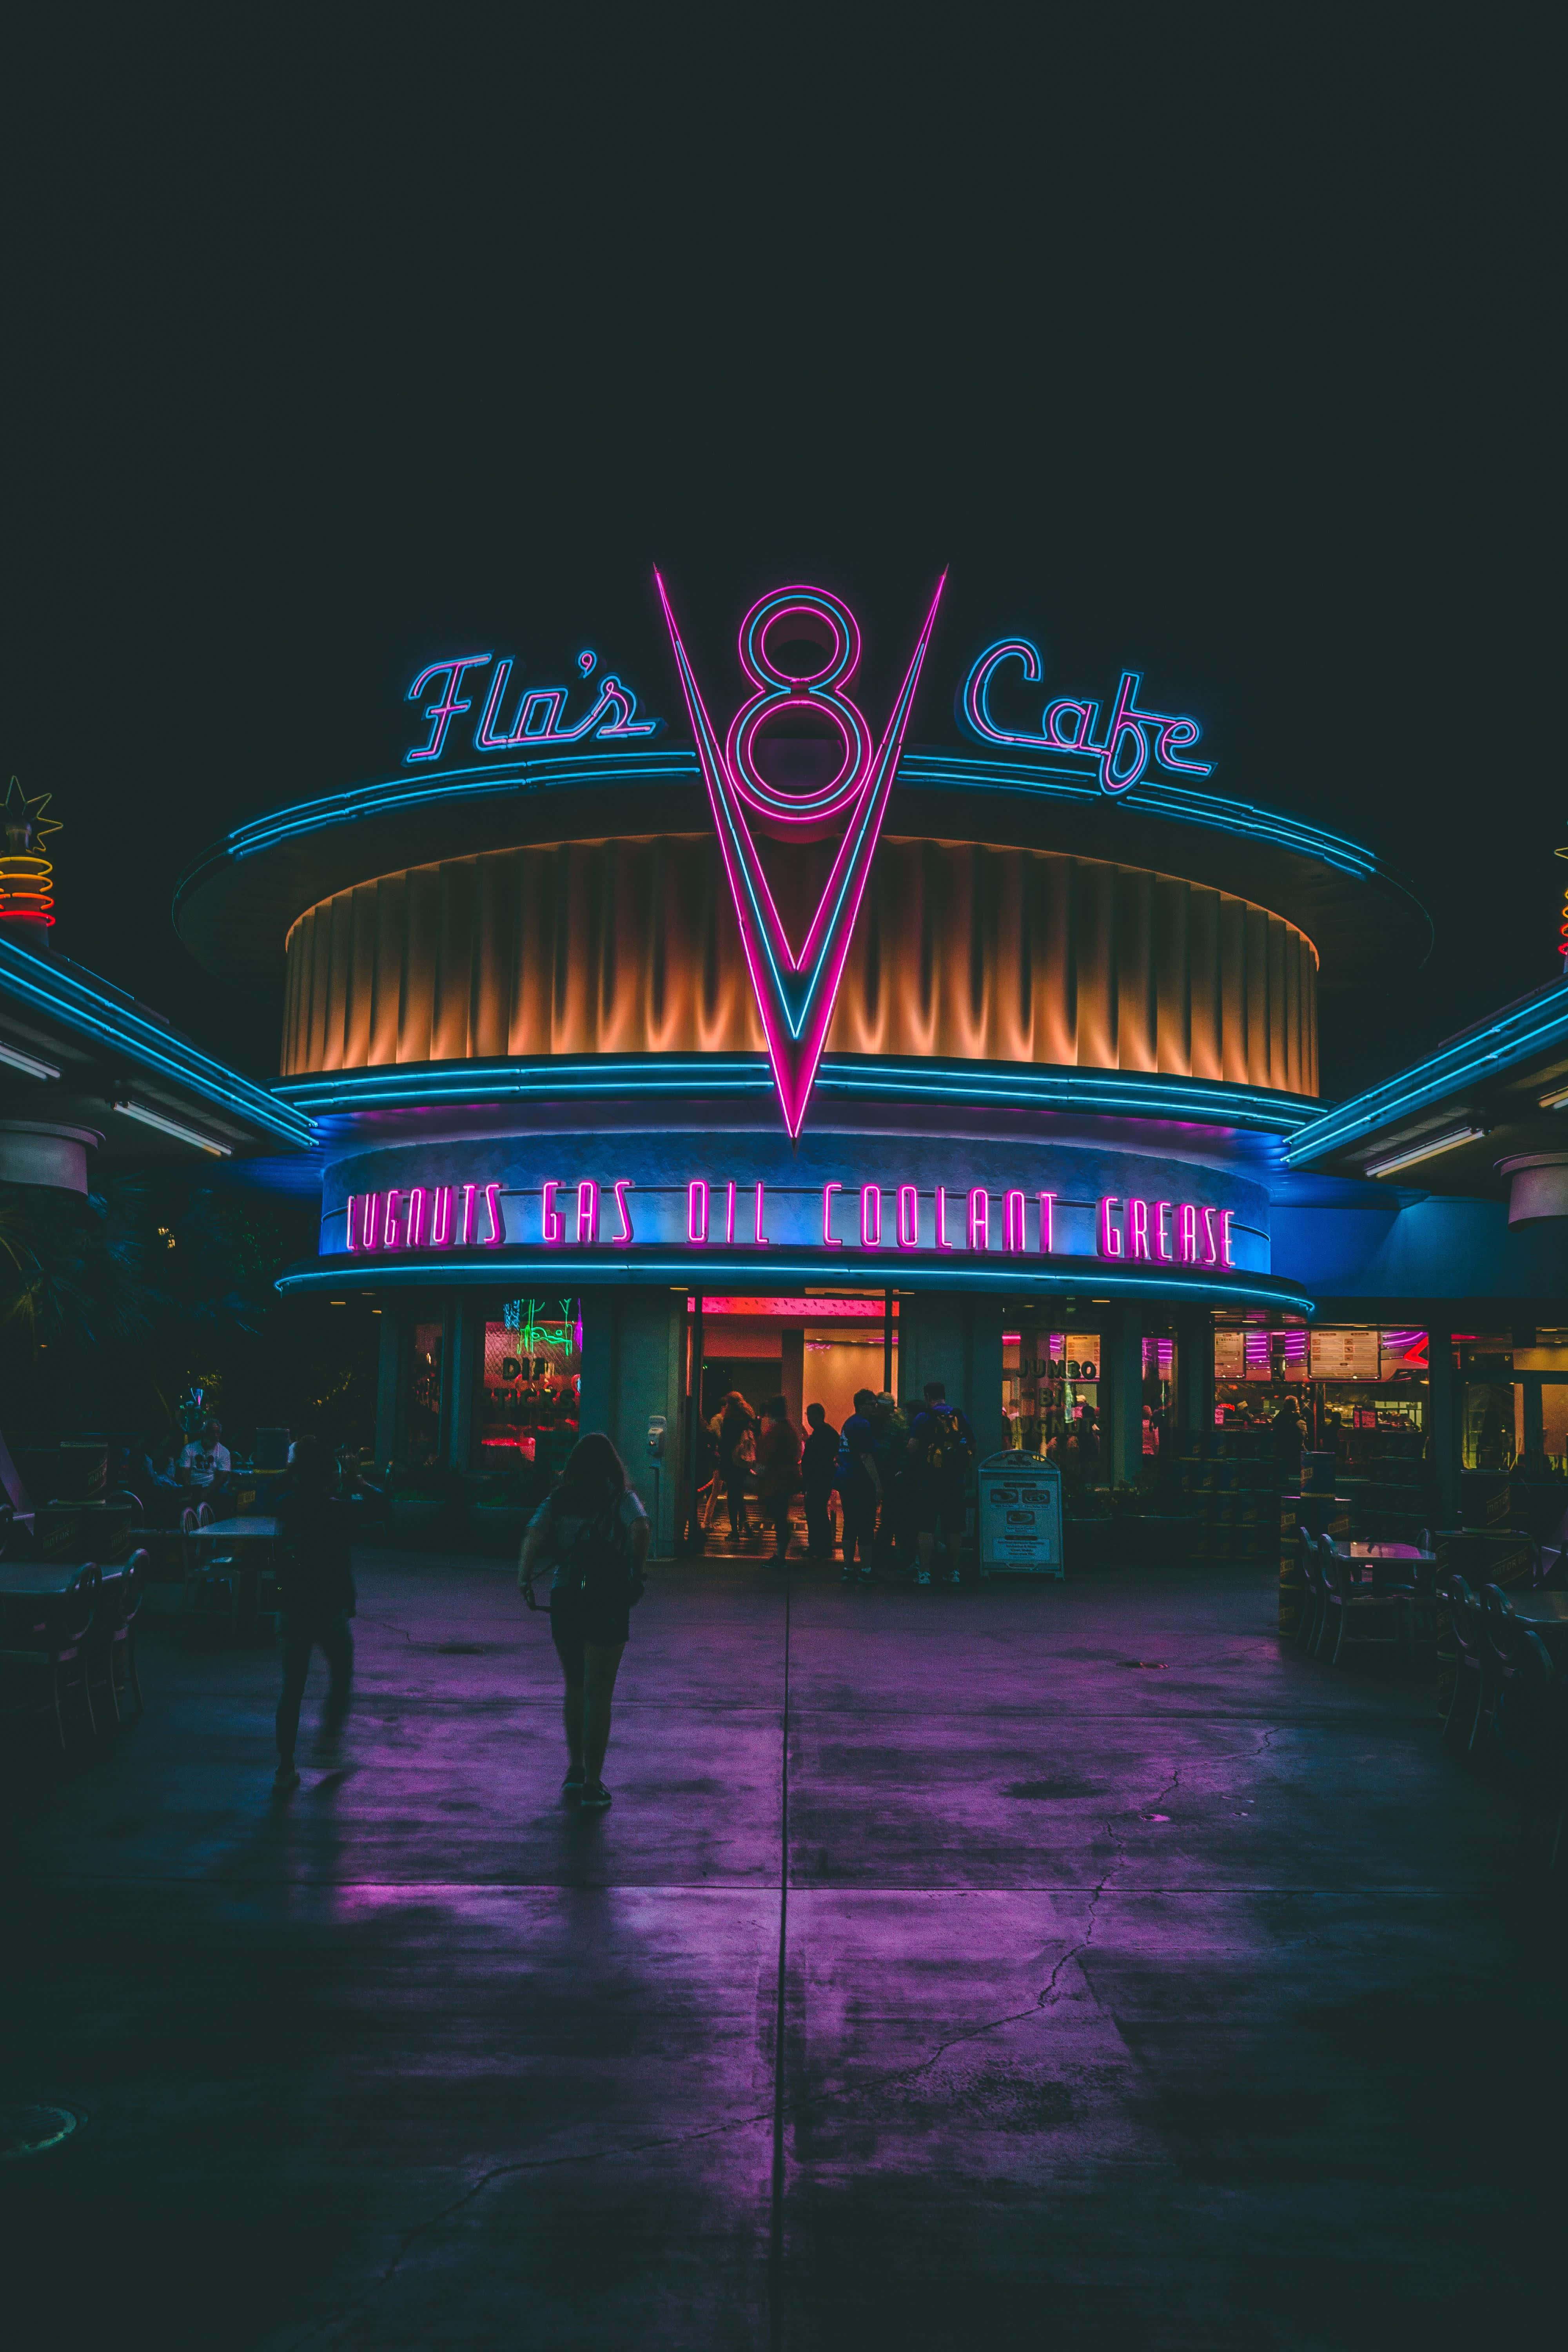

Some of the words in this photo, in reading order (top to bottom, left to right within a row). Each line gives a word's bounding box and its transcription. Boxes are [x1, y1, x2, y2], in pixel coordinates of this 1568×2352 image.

[405, 648, 663, 764] Flo's
[961, 636, 1218, 796] Cafe
[346, 1182, 506, 1250] LUGNUTS
[543, 1180, 635, 1243] GAS
[687, 1180, 770, 1244] OIL
[822, 1182, 1058, 1253] COOLANT
[1096, 1196, 1236, 1268] GREASE
[1016, 1359, 1096, 1379] JUMBO
